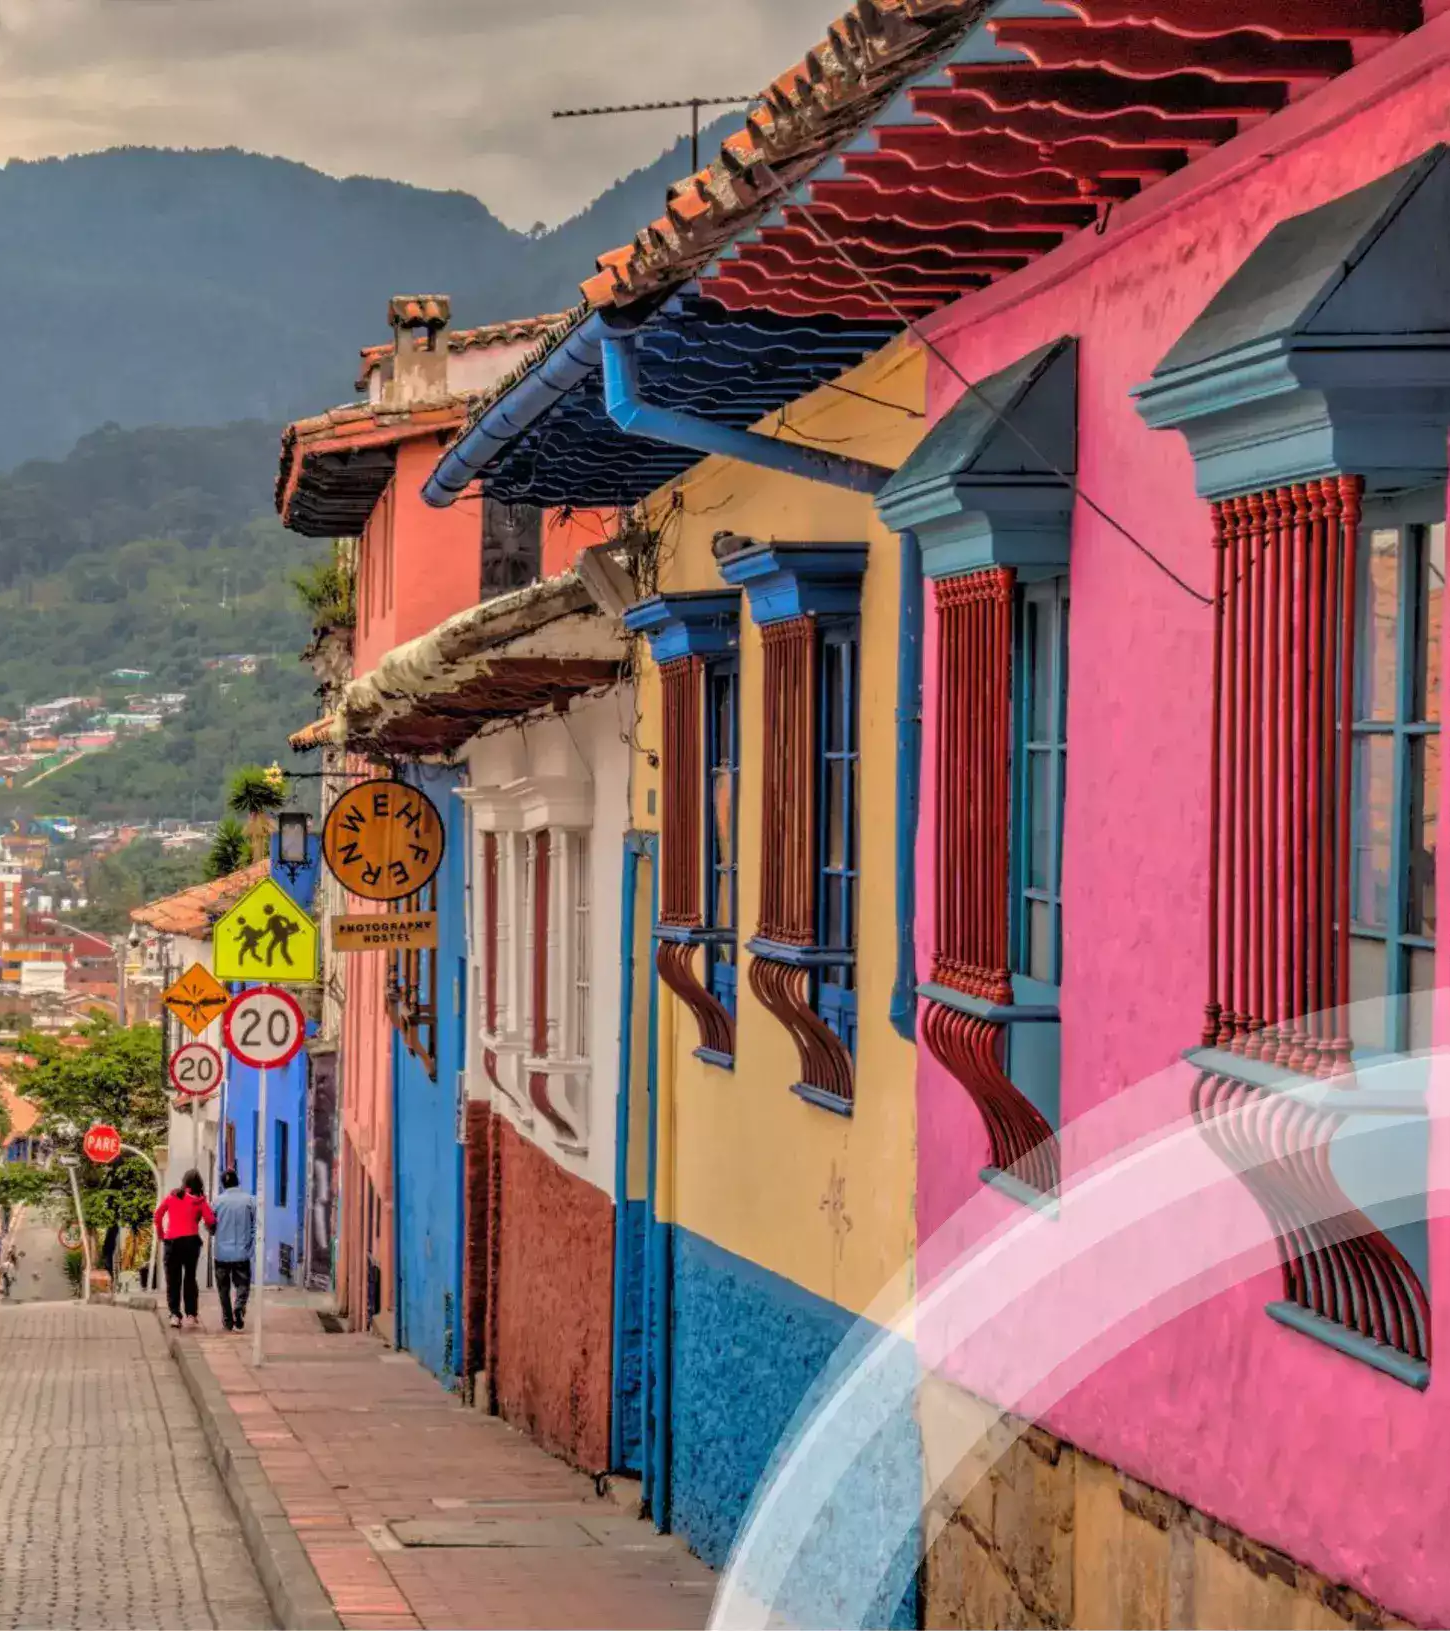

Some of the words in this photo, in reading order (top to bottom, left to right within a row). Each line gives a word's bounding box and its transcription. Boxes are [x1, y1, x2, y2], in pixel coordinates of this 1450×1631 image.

[338, 921, 432, 933] PHOTOGRAPHY
[363, 933, 410, 943] HOSTEL
[239, 1008, 289, 1046] 20
[180, 1056, 212, 1080] 20
[87, 1135, 119, 1153] PARE
